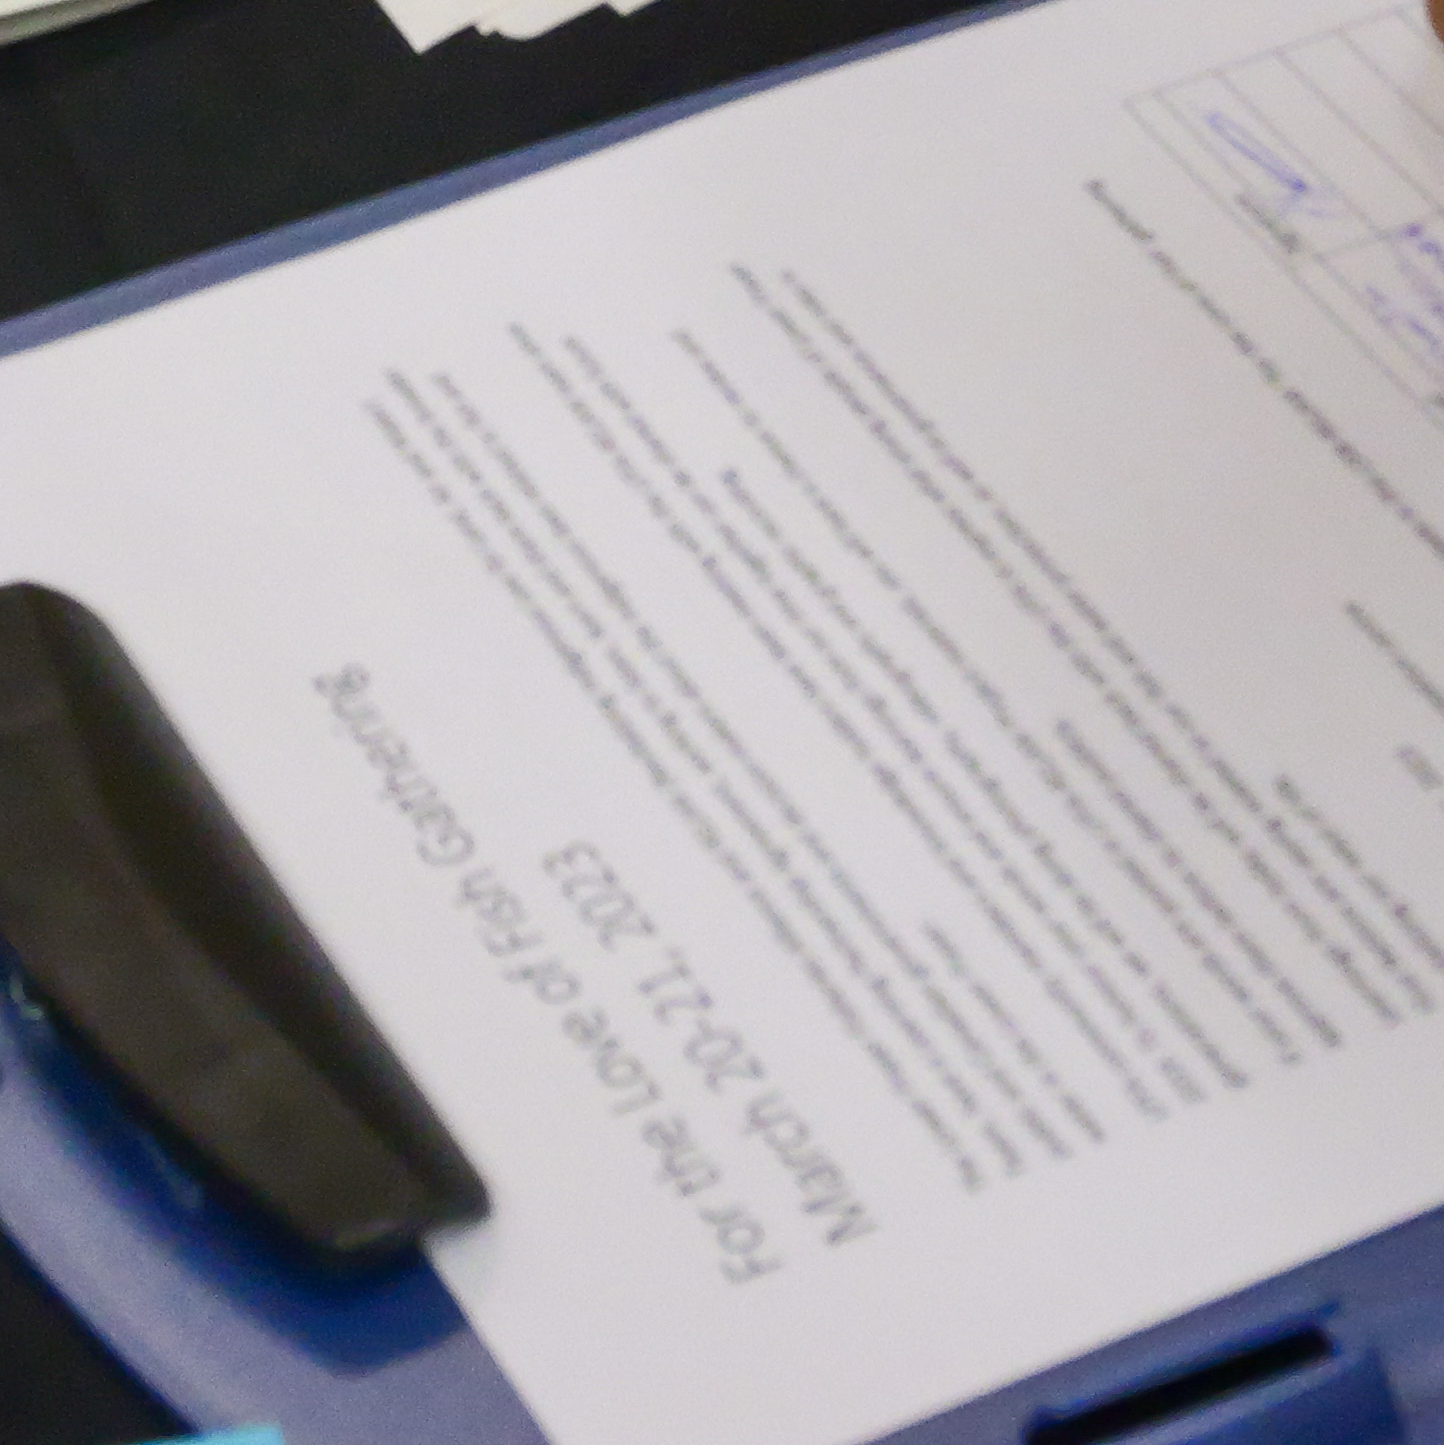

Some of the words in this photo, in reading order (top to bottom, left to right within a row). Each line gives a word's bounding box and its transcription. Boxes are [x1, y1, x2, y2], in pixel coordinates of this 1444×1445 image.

[311, 662, 477, 868] Gathering
[459, 866, 545, 958] Fish
[542, 840, 657, 952] 2023
[503, 959, 583, 1006] of
[637, 942, 766, 1095] 20-21,
[560, 1007, 662, 1116] Love
[640, 1114, 721, 1198] the
[743, 1088, 880, 1247] March
[700, 1204, 786, 1285] For
